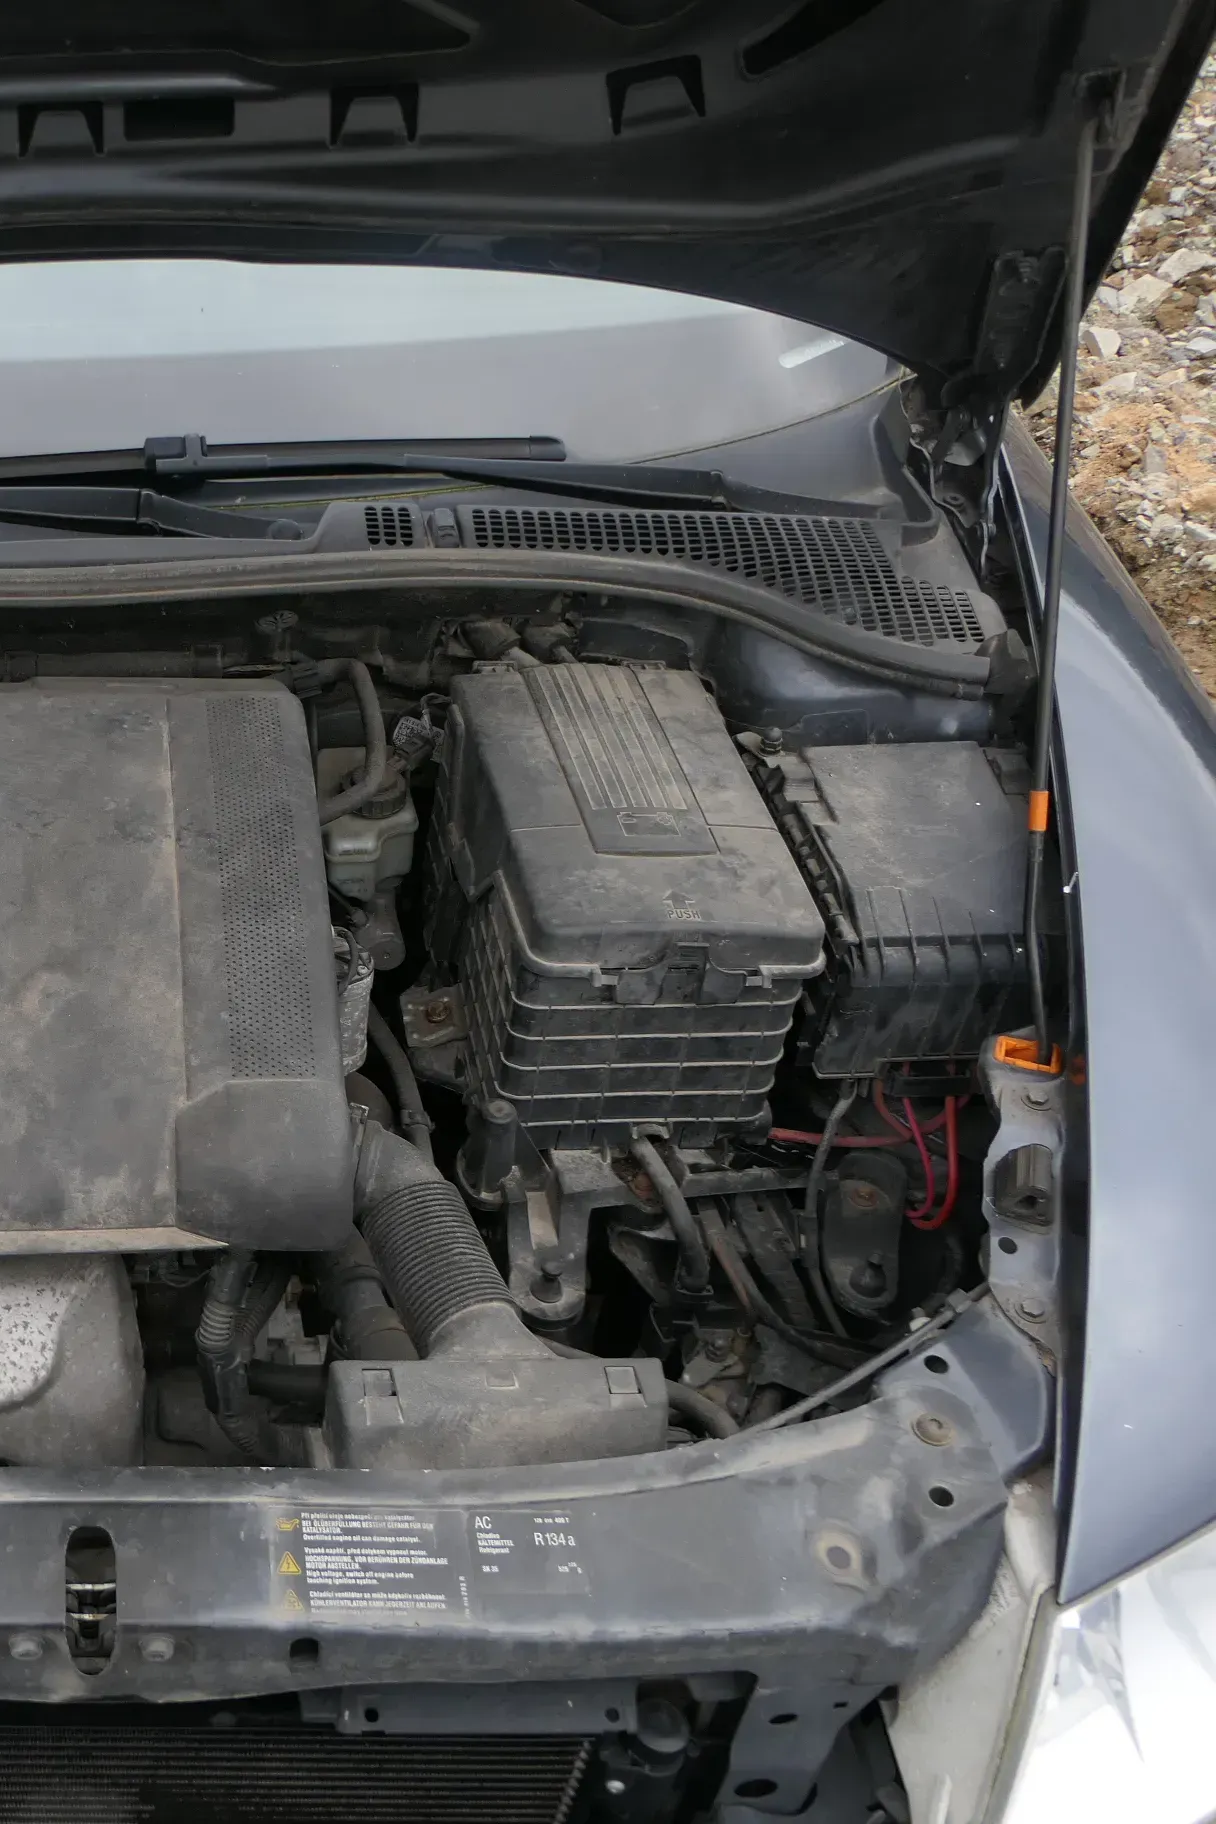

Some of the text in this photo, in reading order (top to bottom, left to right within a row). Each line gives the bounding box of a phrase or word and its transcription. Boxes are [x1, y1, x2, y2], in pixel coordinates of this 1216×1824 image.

[667, 909, 701, 919] PUSH
[474, 1516, 492, 1529] AC
[534, 1532, 576, 1546] R 134 a
